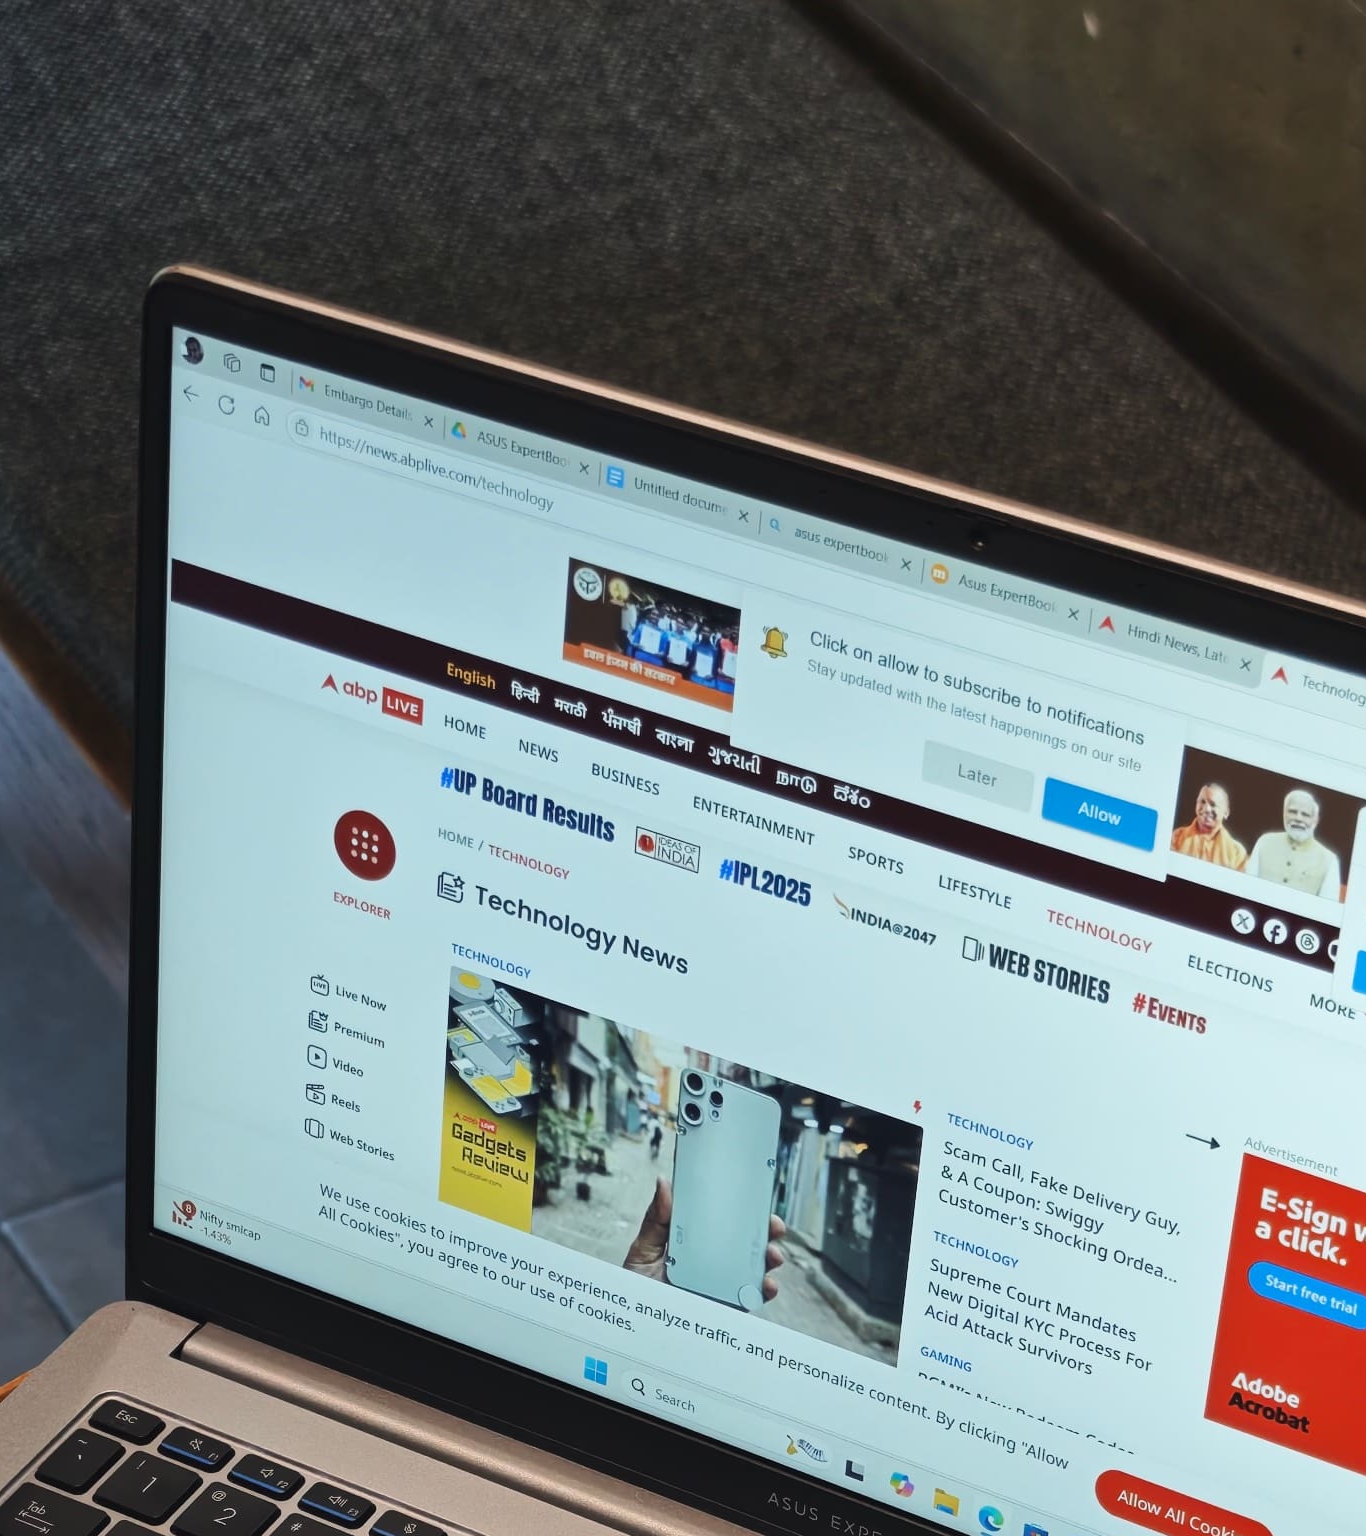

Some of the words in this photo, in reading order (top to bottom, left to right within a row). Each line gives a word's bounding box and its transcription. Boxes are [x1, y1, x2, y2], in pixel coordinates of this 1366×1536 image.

[324, 383, 373, 409] Embargo
[476, 430, 507, 449] ASUS
[319, 425, 553, 513] https://news.abplive.com/technology
[634, 476, 679, 501] Untitled
[957, 573, 986, 592] Asus
[1163, 633, 1200, 657] News,
[342, 680, 378, 704] abp
[447, 662, 495, 689] English
[510, 680, 540, 703] हिन्दी
[809, 630, 848, 655] Click
[877, 653, 919, 676] allow
[942, 674, 1021, 707] subscribe
[1046, 705, 1144, 745] notifications
[386, 695, 418, 716] LIVE
[553, 697, 587, 719] मराठी
[444, 714, 486, 739] HOME
[654, 728, 694, 753] বাংলা
[518, 738, 558, 762] NEWS
[591, 762, 659, 795] BUSINESS
[957, 763, 997, 787] Later
[440, 766, 477, 795] #UP
[481, 776, 538, 817] Board
[542, 797, 614, 842] Results
[693, 795, 815, 845] ENTERTAINMENT
[1077, 801, 1121, 825] Allow
[437, 827, 474, 848] HOME
[488, 843, 570, 880] TECHNOLOGY
[656, 844, 695, 868] INDIA
[847, 845, 903, 874] SPORTS
[719, 858, 811, 906] #IPL2025
[938, 874, 1011, 910] LIFESTYLE
[333, 891, 390, 920] EXPLORER
[474, 884, 616, 955] Technology
[622, 934, 688, 974] News
[850, 907, 936, 945] INDIA@2047
[1046, 908, 1152, 953] TECHNOLOGY
[451, 942, 531, 978] TECHNOLOGY
[988, 942, 1030, 978] WEB
[1032, 958, 1110, 1004] STORIES
[1187, 954, 1273, 992] ELECTIONS
[335, 984, 358, 1002] Live
[360, 993, 386, 1011] Now
[1309, 993, 1355, 1019] MORE
[333, 1021, 384, 1048] Premium
[332, 1057, 363, 1077] Video
[331, 1093, 360, 1112] Reels
[329, 1128, 353, 1146] Web
[356, 1139, 394, 1161] Stories
[451, 1122, 526, 1162] Gadgets
[947, 1112, 1034, 1150] TECHNOLOGY
[461, 1145, 528, 1184] Review
[1243, 1136, 1338, 1176] Advertisement
[943, 1140, 986, 1167] Scam
[991, 1157, 1024, 1182] Call,
[1030, 1170, 1068, 1195] Fake
[1072, 1184, 1141, 1222] Delivery
[1144, 1210, 1180, 1236] Guy,
[973, 1176, 1040, 1211] Coupon:
[1044, 1200, 1104, 1235] Swiggy
[199, 1209, 223, 1228] Nifty
[1259, 1187, 1347, 1240] E-Sign
[933, 1229, 1018, 1268] TECHNOLOGY
[938, 1188, 1028, 1231] Customer's
[1033, 1221, 1108, 1262] Shocking
[1113, 1249, 1176, 1282] Ordea...
[1277, 1226, 1346, 1266] click.
[318, 1204, 335, 1221] All
[438, 1250, 479, 1274] agree
[577, 1302, 635, 1332] cookies.
[929, 1257, 1001, 1294] Supreme
[1006, 1285, 1051, 1312] Court
[1055, 1301, 1136, 1342] Mandates
[1265, 1274, 1297, 1295] Start
[1300, 1285, 1327, 1305] free
[1330, 1296, 1357, 1315] trial
[374, 1206, 426, 1233] cookies
[448, 1230, 507, 1263] improve
[510, 1255, 544, 1276] your
[547, 1270, 630, 1310] experience,
[634, 1302, 690, 1331] analyze
[694, 1322, 740, 1350] traffic,
[777, 1354, 864, 1395] personalize
[868, 1388, 930, 1419] content.
[958, 1420, 1016, 1454] clicking
[923, 1304, 958, 1326] Acid
[961, 1317, 1013, 1347] Attack
[1017, 1337, 1092, 1375] Survivors
[927, 1280, 963, 1304] New
[967, 1294, 1019, 1325] Digital
[1023, 1314, 1055, 1337] KYC
[1059, 1327, 1120, 1360] Process
[1125, 1351, 1151, 1371] For
[920, 1345, 971, 1372] GAMING
[655, 1388, 695, 1413] Search
[1231, 1371, 1300, 1408] Adobe
[114, 1409, 138, 1423] Esc
[1227, 1390, 1310, 1433] Acrobat
[26, 1500, 46, 1514] Tab
[768, 1492, 819, 1521] ASUS
[1116, 1489, 1160, 1516] Allow
[1164, 1506, 1185, 1525] All
